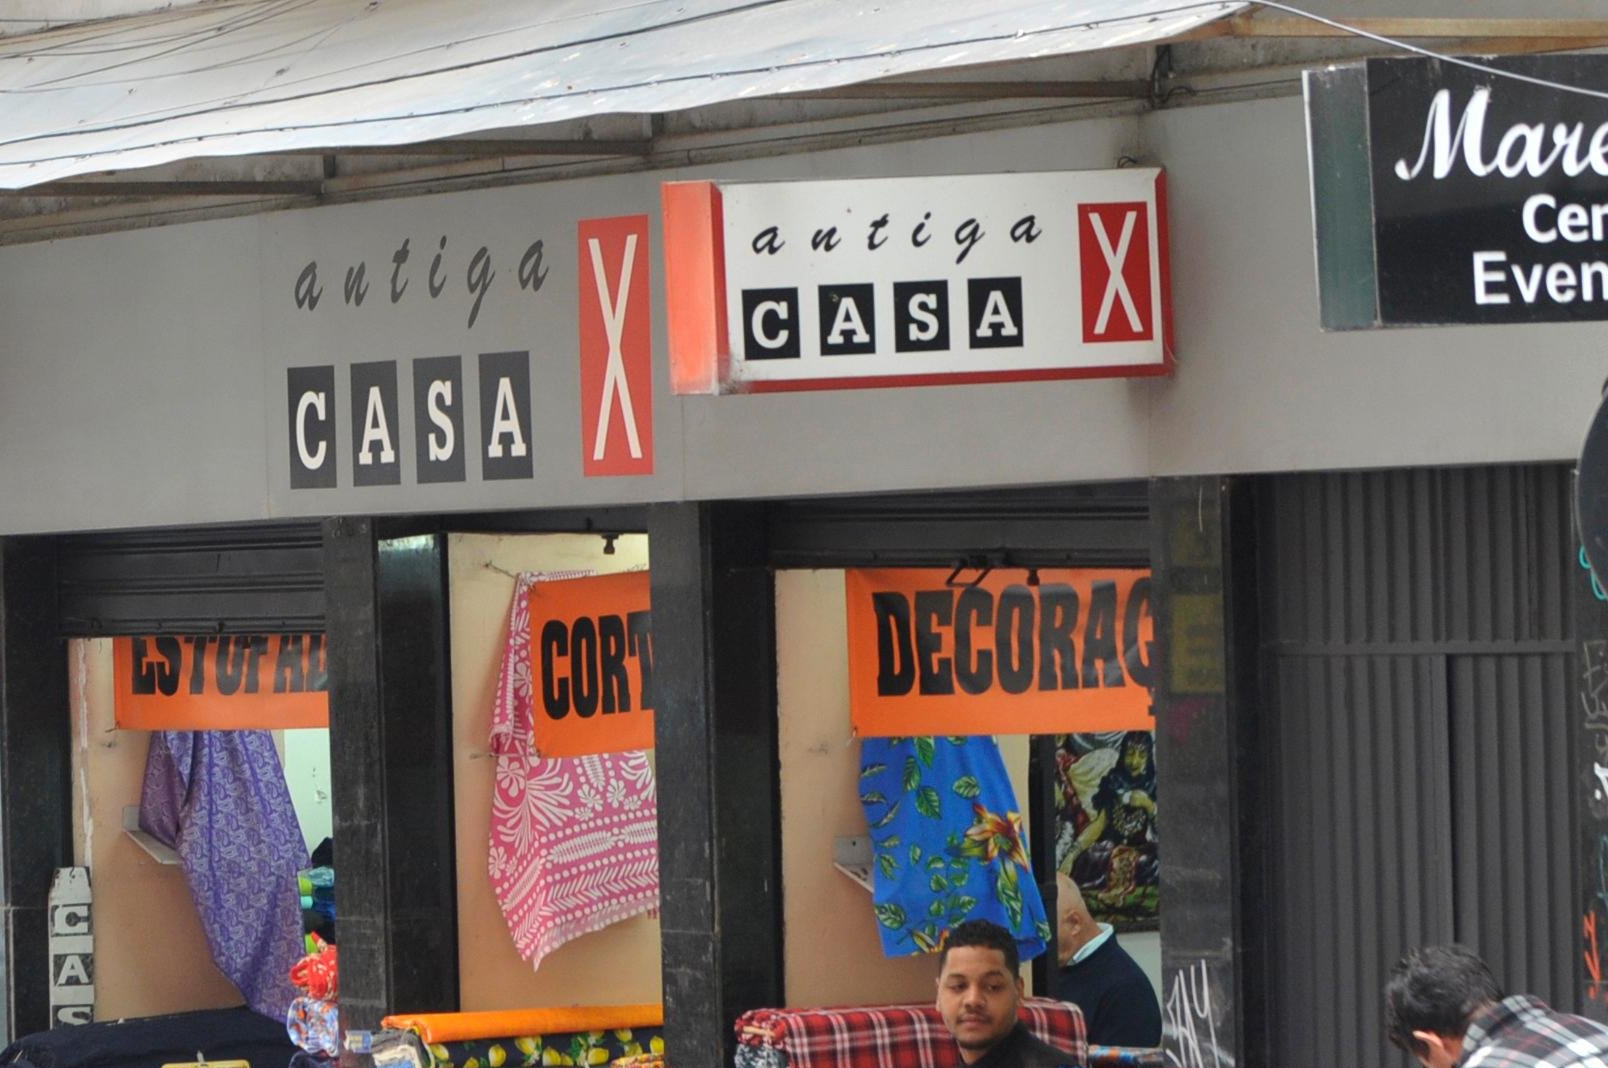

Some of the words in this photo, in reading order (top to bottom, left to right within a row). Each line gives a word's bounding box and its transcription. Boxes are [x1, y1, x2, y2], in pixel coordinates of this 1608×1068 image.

[750, 290, 1020, 350] CASA
[751, 211, 1043, 265] antiga
[1088, 210, 1144, 335] X
[1472, 250, 1608, 306] Even
[294, 234, 550, 329] antiga
[587, 234, 643, 461] X
[295, 376, 527, 471] CASA
[541, 610, 655, 721] CORT
[872, 577, 1156, 718] DECORAÇ
